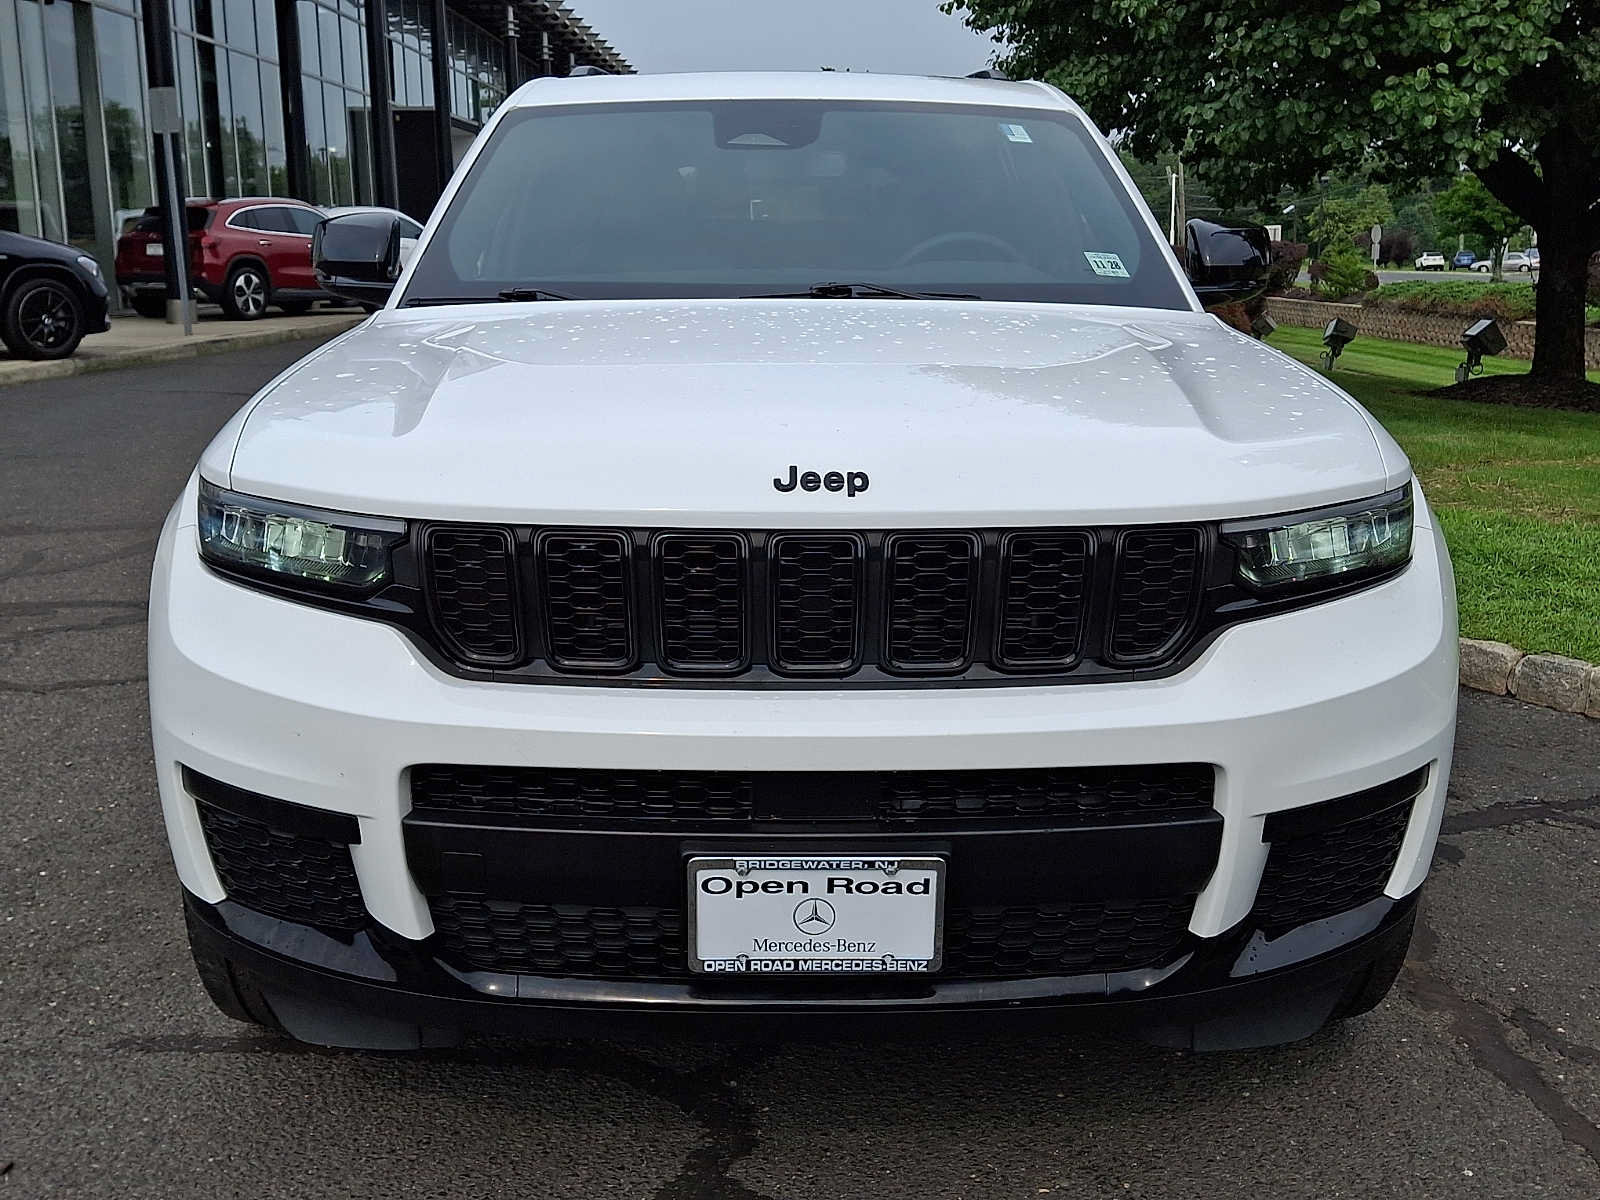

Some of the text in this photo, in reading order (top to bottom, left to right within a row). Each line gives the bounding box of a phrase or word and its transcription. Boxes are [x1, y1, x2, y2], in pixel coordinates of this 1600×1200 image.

[773, 465, 869, 497] Jeep
[875, 860, 898, 870] NJ
[701, 876, 930, 899] Open Road
[752, 938, 876, 953] Mercedes-Benz
[703, 960, 746, 972] OPEN
[750, 960, 794, 971] ROAD
